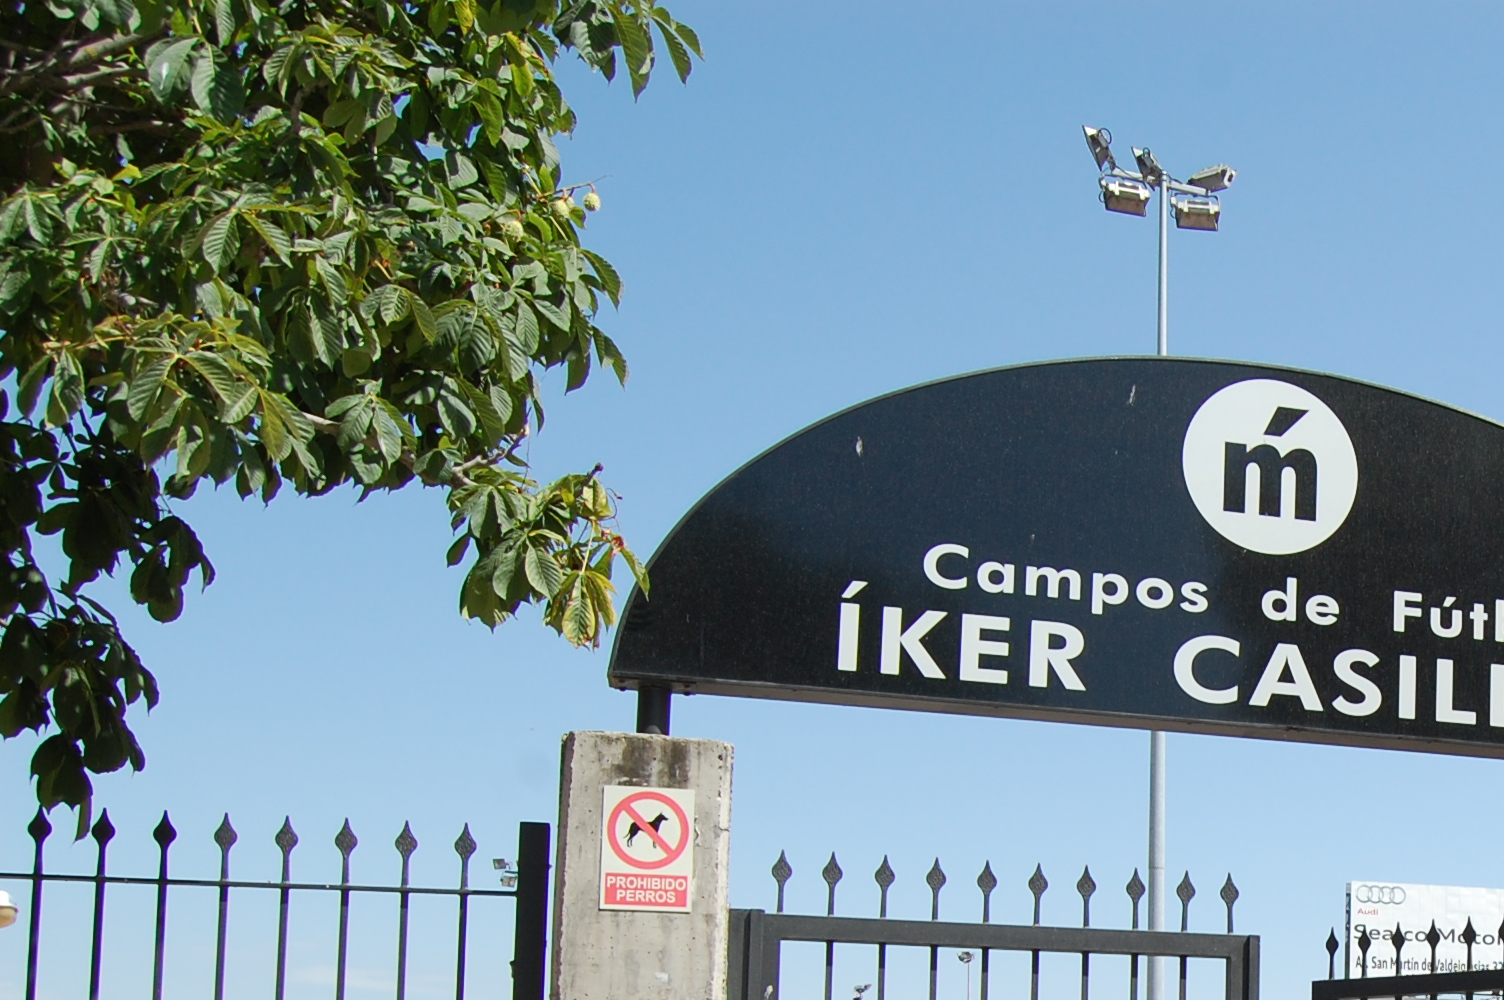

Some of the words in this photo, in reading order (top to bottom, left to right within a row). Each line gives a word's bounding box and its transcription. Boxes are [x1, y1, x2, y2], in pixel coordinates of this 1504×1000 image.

[923, 543, 1209, 618] Campos
[1261, 576, 1340, 626] de
[837, 580, 1087, 692] ÍKER
[607, 876, 686, 890] PROHIBIDO
[616, 889, 676, 903] PERROS
[1356, 907, 1379, 916] Audi
[1353, 923, 1429, 943] Seaco
[1371, 956, 1388, 969] San
[1390, 956, 1419, 971] Mrtín
